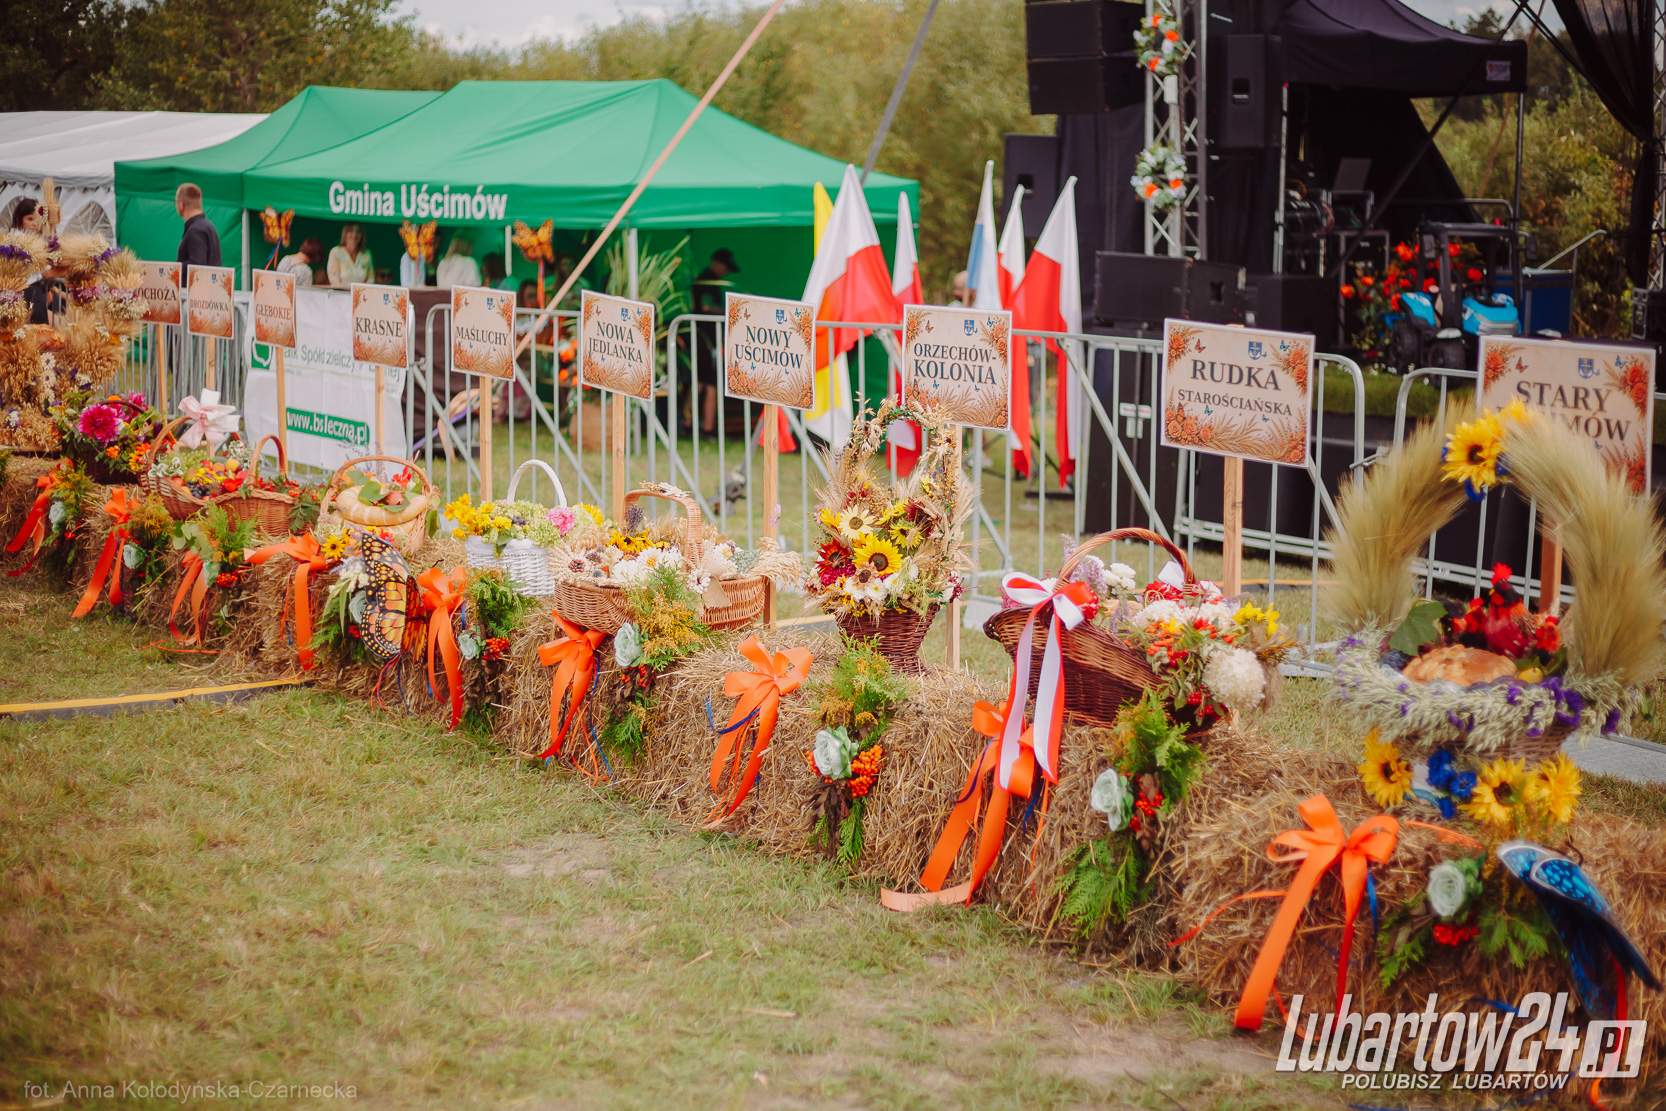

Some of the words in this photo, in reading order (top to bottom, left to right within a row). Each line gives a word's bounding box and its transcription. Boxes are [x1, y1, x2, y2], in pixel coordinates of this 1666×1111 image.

[329, 180, 395, 217] Gmina
[400, 183, 508, 220] Uścimów
[355, 317, 403, 338] KRASNE
[455, 323, 509, 346] MAŚLUCHY
[596, 321, 635, 345] NOWA
[746, 325, 792, 349] NOWY
[588, 337, 643, 364] JEDLANKA
[735, 342, 804, 369] UŚCIMÓW
[913, 342, 997, 363] ORZECHÓW-
[913, 358, 998, 385] KOLONIA
[1190, 358, 1282, 391] RUDKA
[1177, 388, 1293, 417] STAROŚCIAŃSKA
[1516, 380, 1612, 413] STARY
